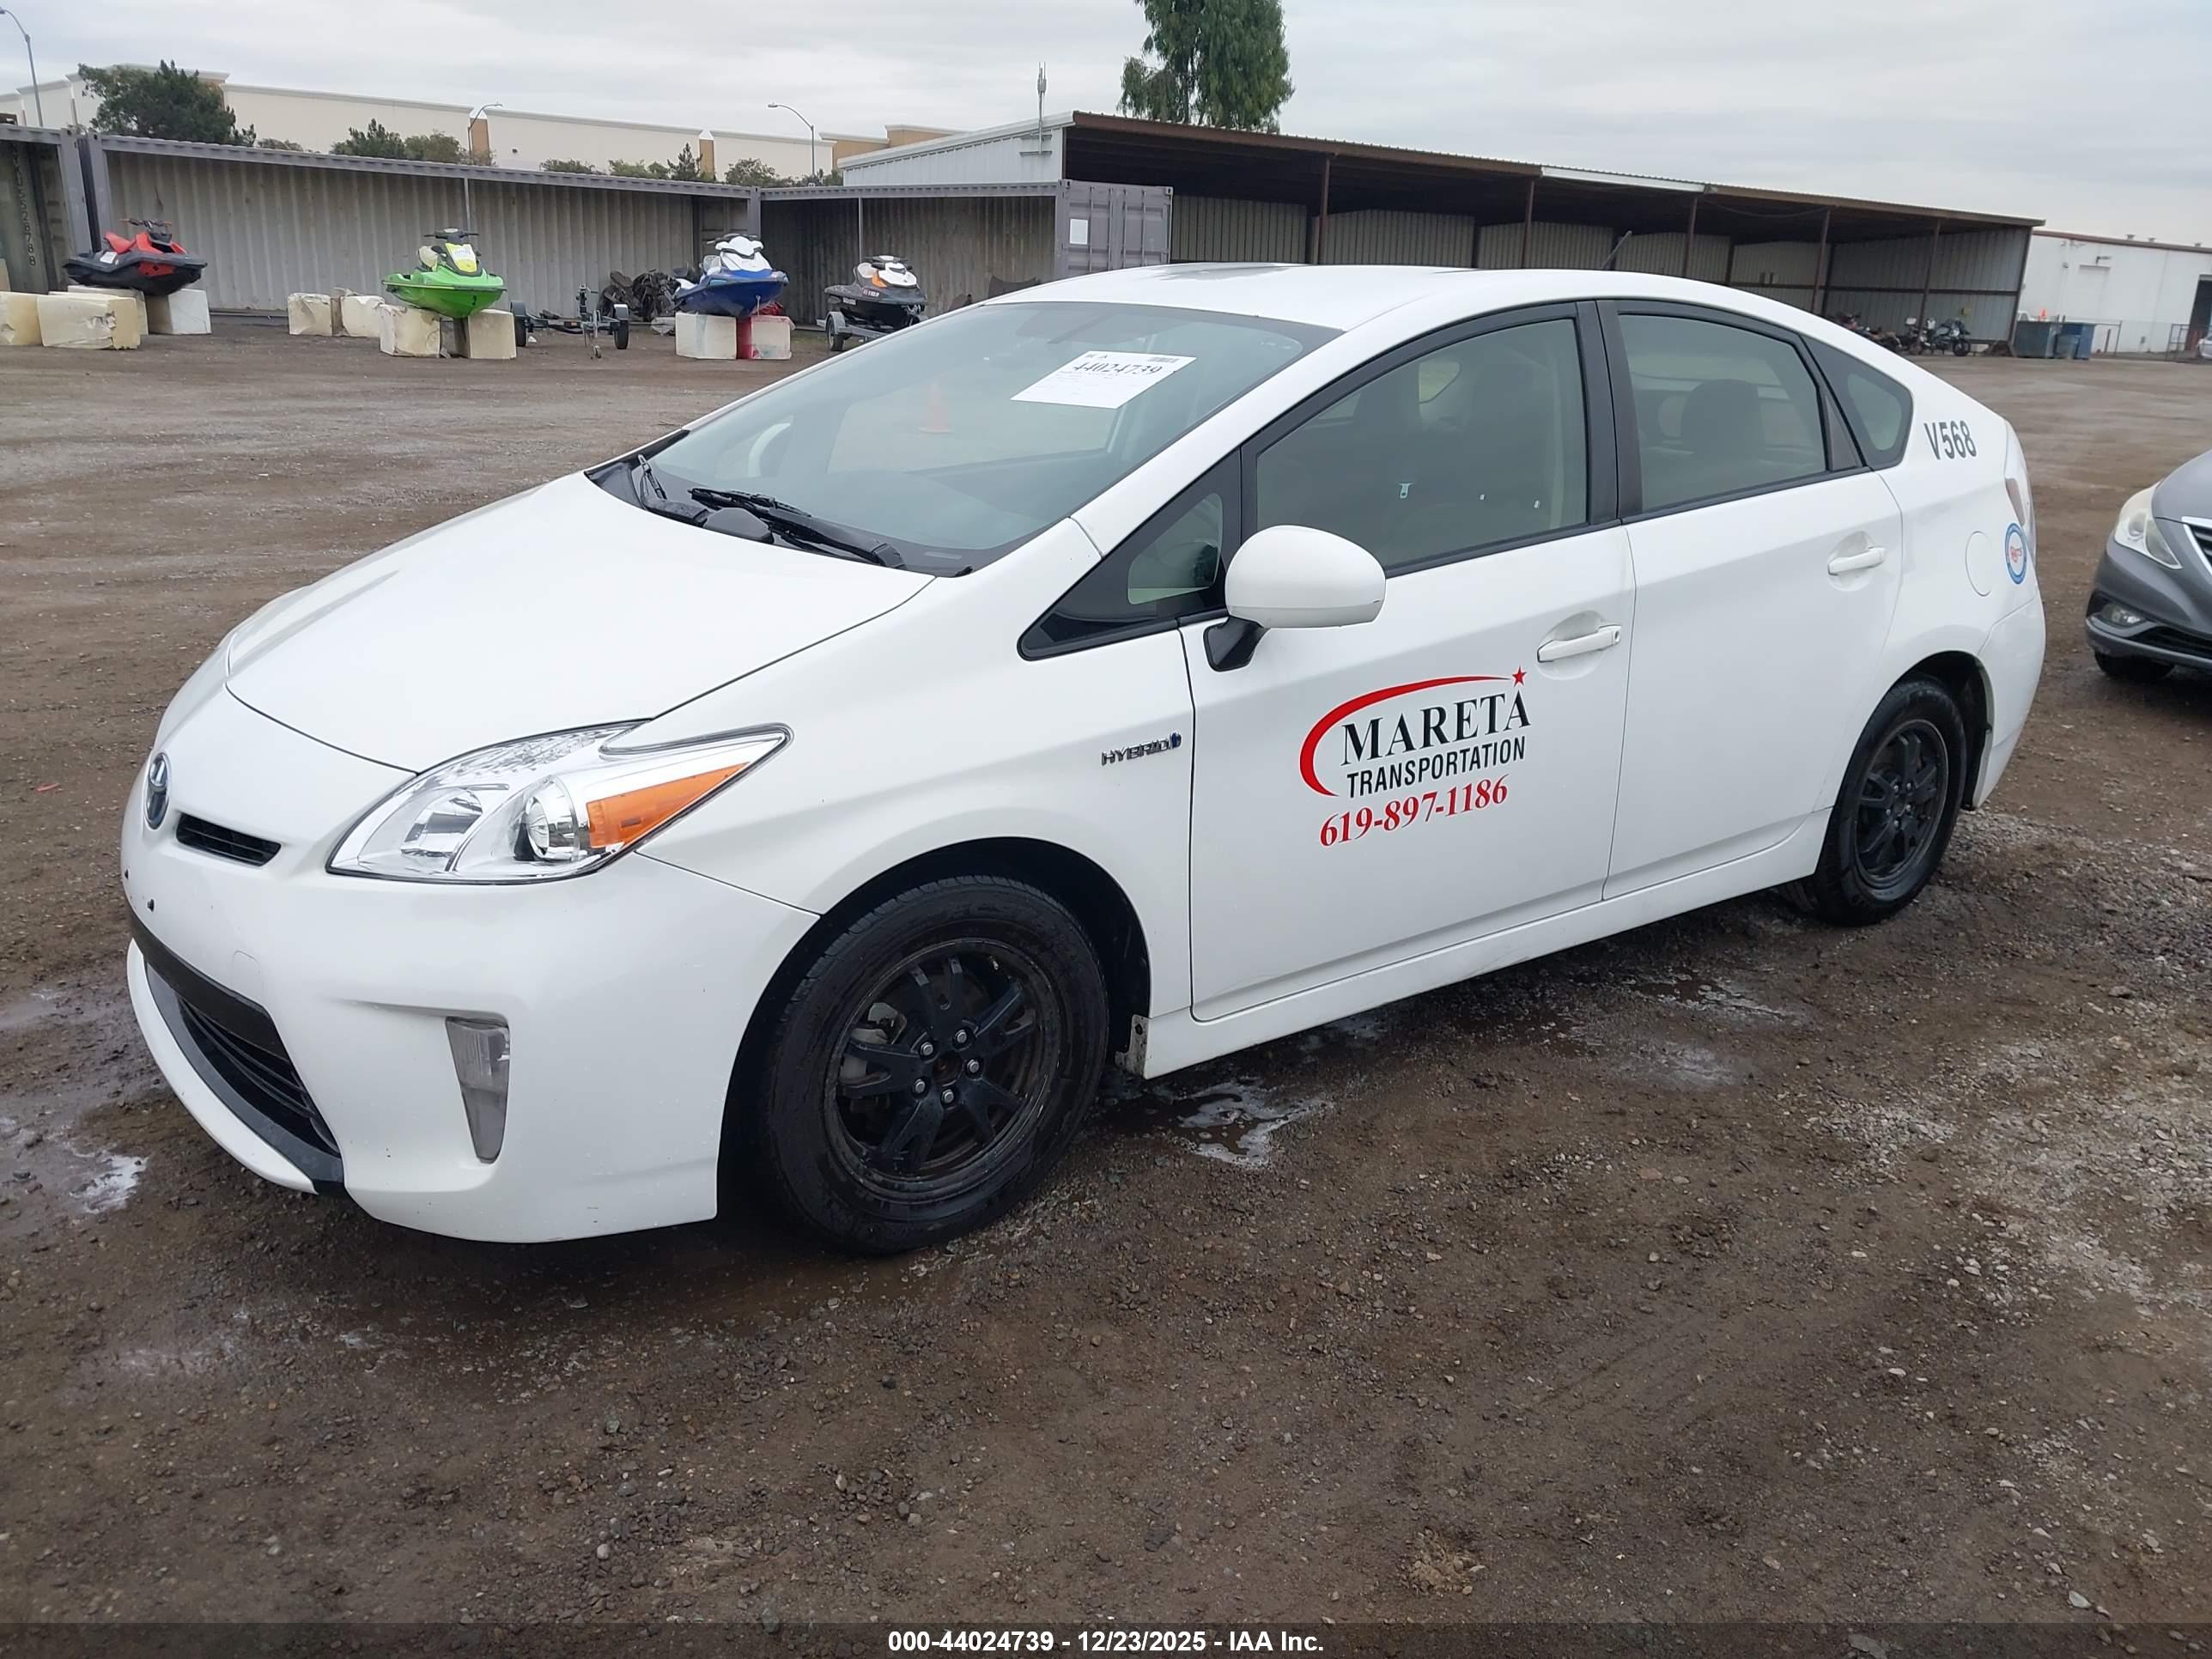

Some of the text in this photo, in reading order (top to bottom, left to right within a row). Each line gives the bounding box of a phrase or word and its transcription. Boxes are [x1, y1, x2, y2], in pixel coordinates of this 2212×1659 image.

[1073, 362, 1163, 374] 44024739
[1924, 421, 1978, 460] V568
[1102, 738, 1170, 766] HYBRID
[1340, 690, 1531, 766] MARETA
[1347, 736, 1526, 798] TRANSPORTATION
[1320, 774, 1510, 847] 619-897-1186
